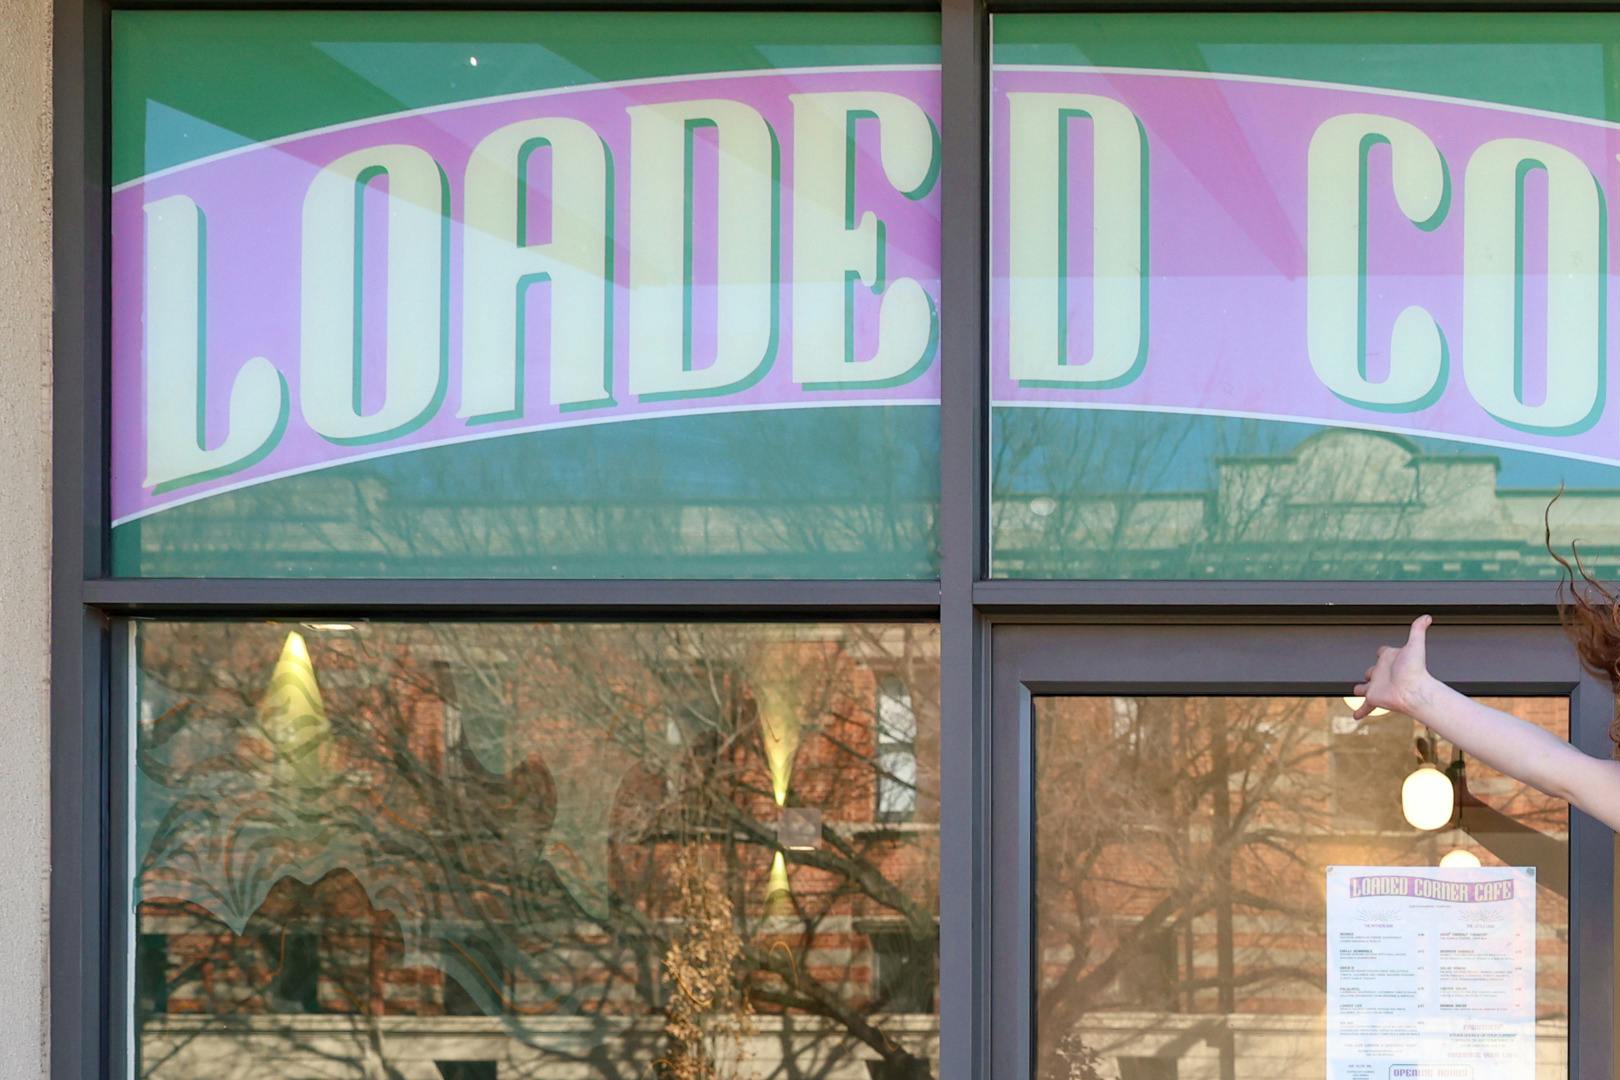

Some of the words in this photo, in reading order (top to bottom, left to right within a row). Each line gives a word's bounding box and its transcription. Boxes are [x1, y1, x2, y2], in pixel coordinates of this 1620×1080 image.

[1353, 877, 1408, 898] LOADED
[1414, 878, 1468, 901] CORNER
[1474, 881, 1512, 901] CAFE
